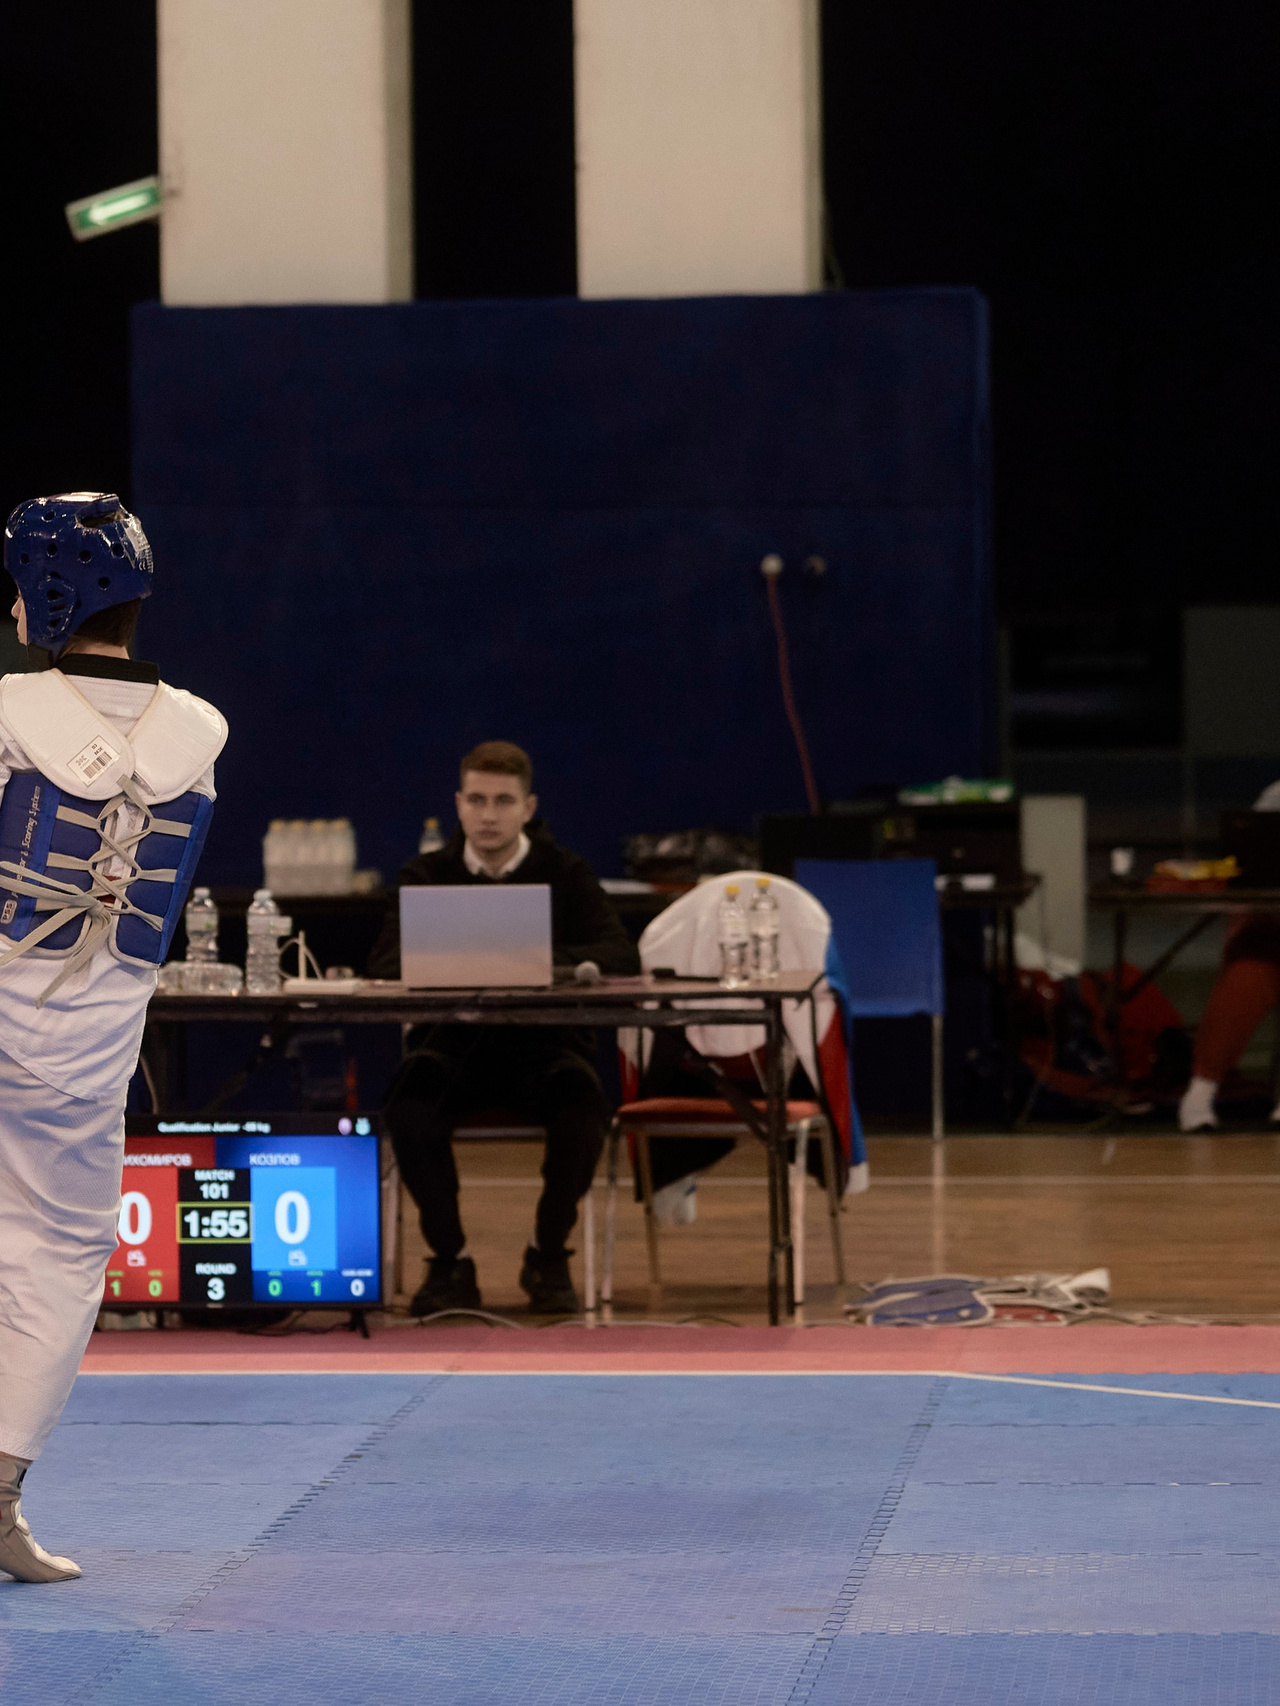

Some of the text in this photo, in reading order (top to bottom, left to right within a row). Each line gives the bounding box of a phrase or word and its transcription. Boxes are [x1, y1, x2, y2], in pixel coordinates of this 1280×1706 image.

[21, 817, 38, 848] Scoring
[249, 1153, 301, 1166] КОЗЛОВ
[195, 1169, 235, 1181] MATCH
[200, 1182, 229, 1200] 101
[118, 1191, 152, 1245] 0
[184, 1210, 248, 1238] 1:55
[274, 1190, 310, 1245] 0
[195, 1262, 237, 1275] ROUND
[110, 1280, 162, 1297] 1 0
[207, 1277, 225, 1301] 3
[268, 1279, 365, 1297] 0 1 0
